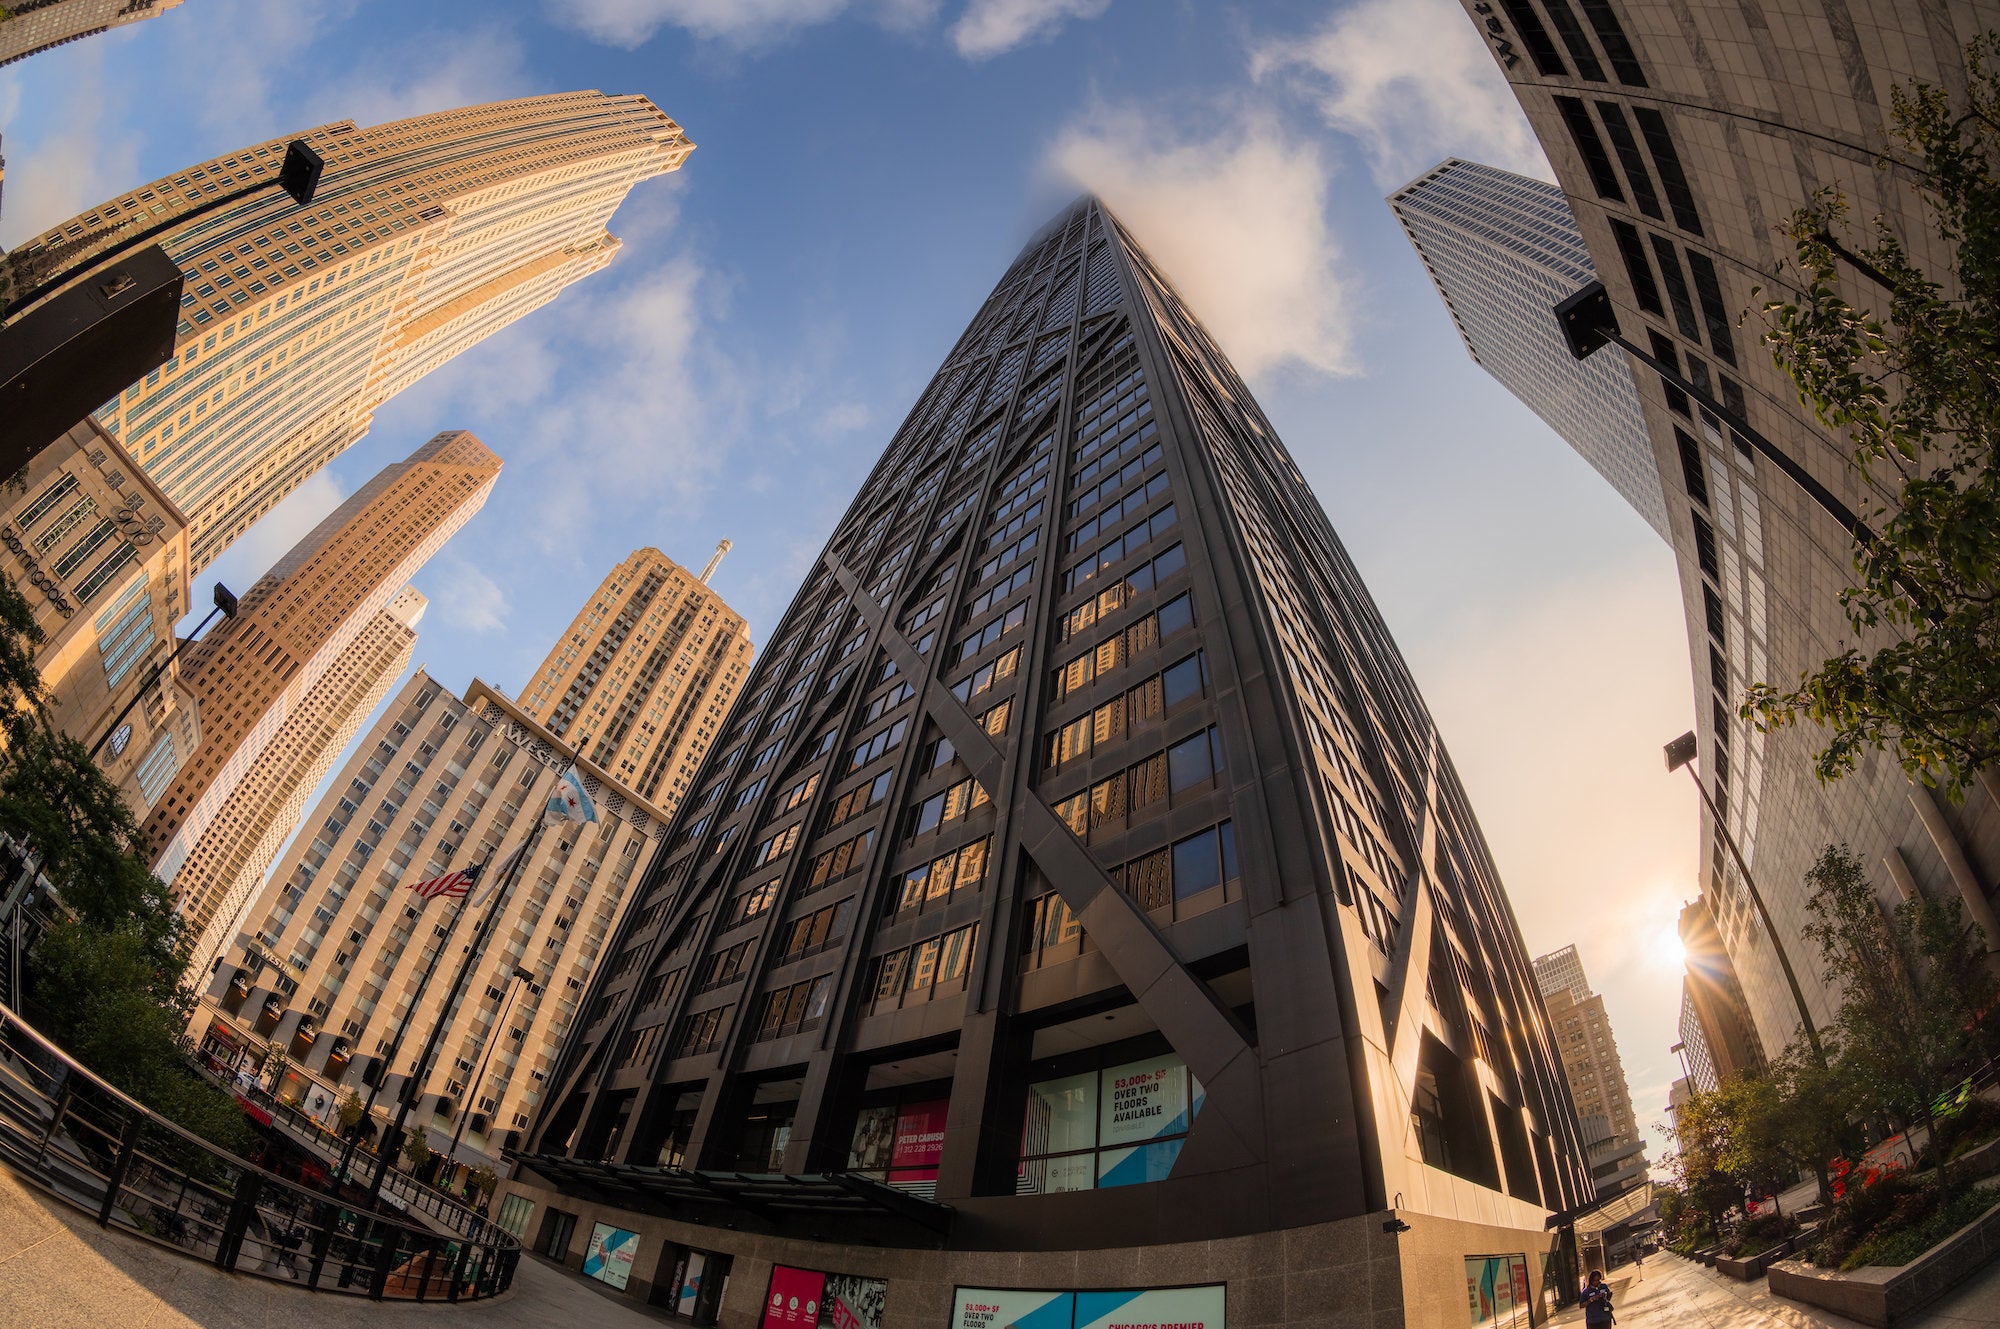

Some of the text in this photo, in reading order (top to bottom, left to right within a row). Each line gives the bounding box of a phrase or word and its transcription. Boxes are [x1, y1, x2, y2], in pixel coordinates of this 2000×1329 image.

[1473, 0, 1519, 71] Wat
[117, 509, 154, 547] 900
[260, 946, 294, 975] WESTIN
[1115, 1074, 1152, 1088] 53,000+
[1114, 1083, 1159, 1099] OVER TWO
[1113, 1097, 1148, 1112] FLOORS
[1113, 1105, 1162, 1123] AVAILABLE
[898, 1132, 944, 1145] PETER CARUSO
[927, 1143, 943, 1151] 2926
[965, 1303, 1001, 1313] 53,000+ SF
[964, 1311, 994, 1321] OVER TWO
[963, 1319, 986, 1329] FLOORS
